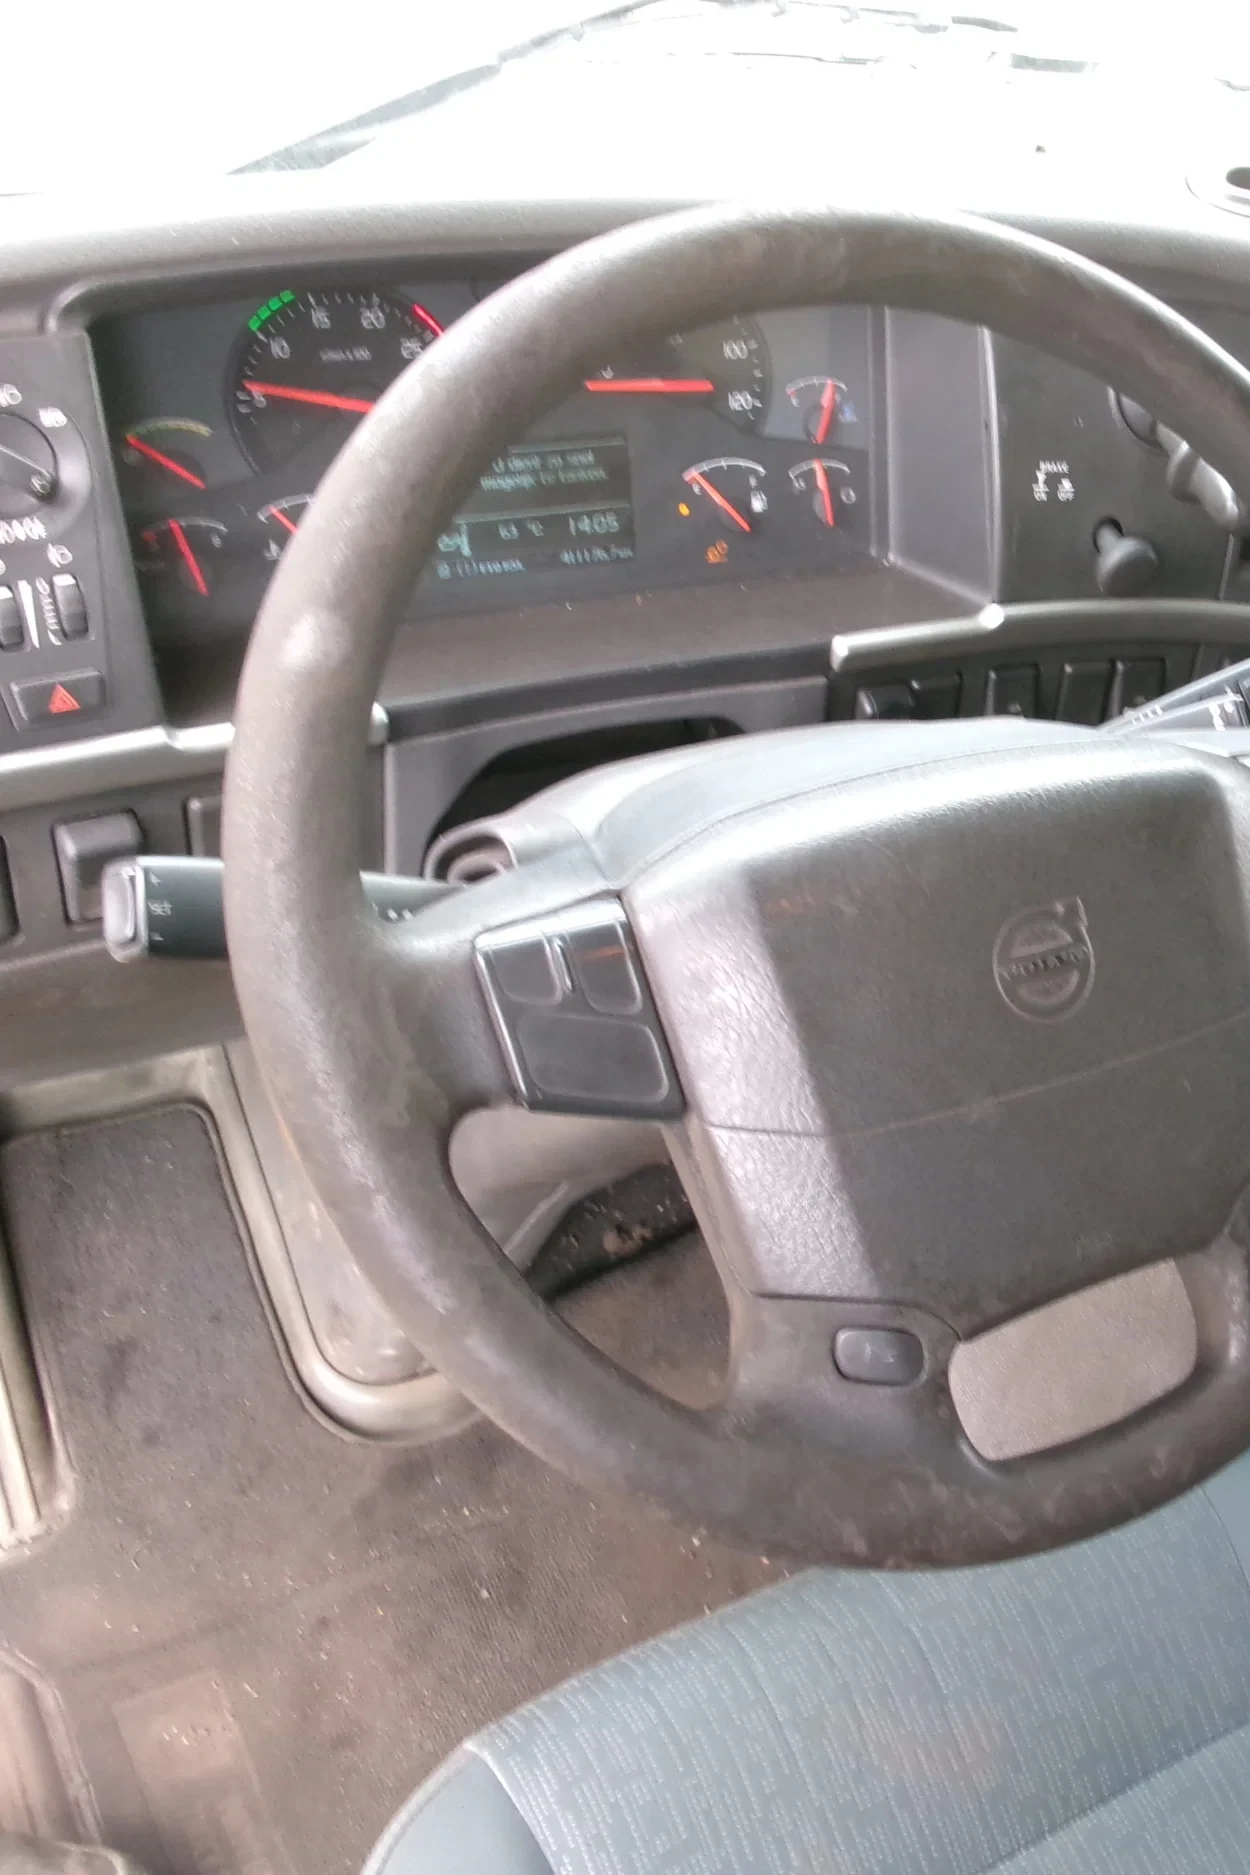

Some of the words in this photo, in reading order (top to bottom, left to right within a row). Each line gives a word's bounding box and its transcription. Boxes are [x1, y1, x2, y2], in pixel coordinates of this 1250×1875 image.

[360, 307, 386, 329] 20
[270, 336, 291, 359] 10
[723, 340, 748, 360] 100
[728, 391, 753, 411] 120
[1039, 460, 1070, 473] BRAKE
